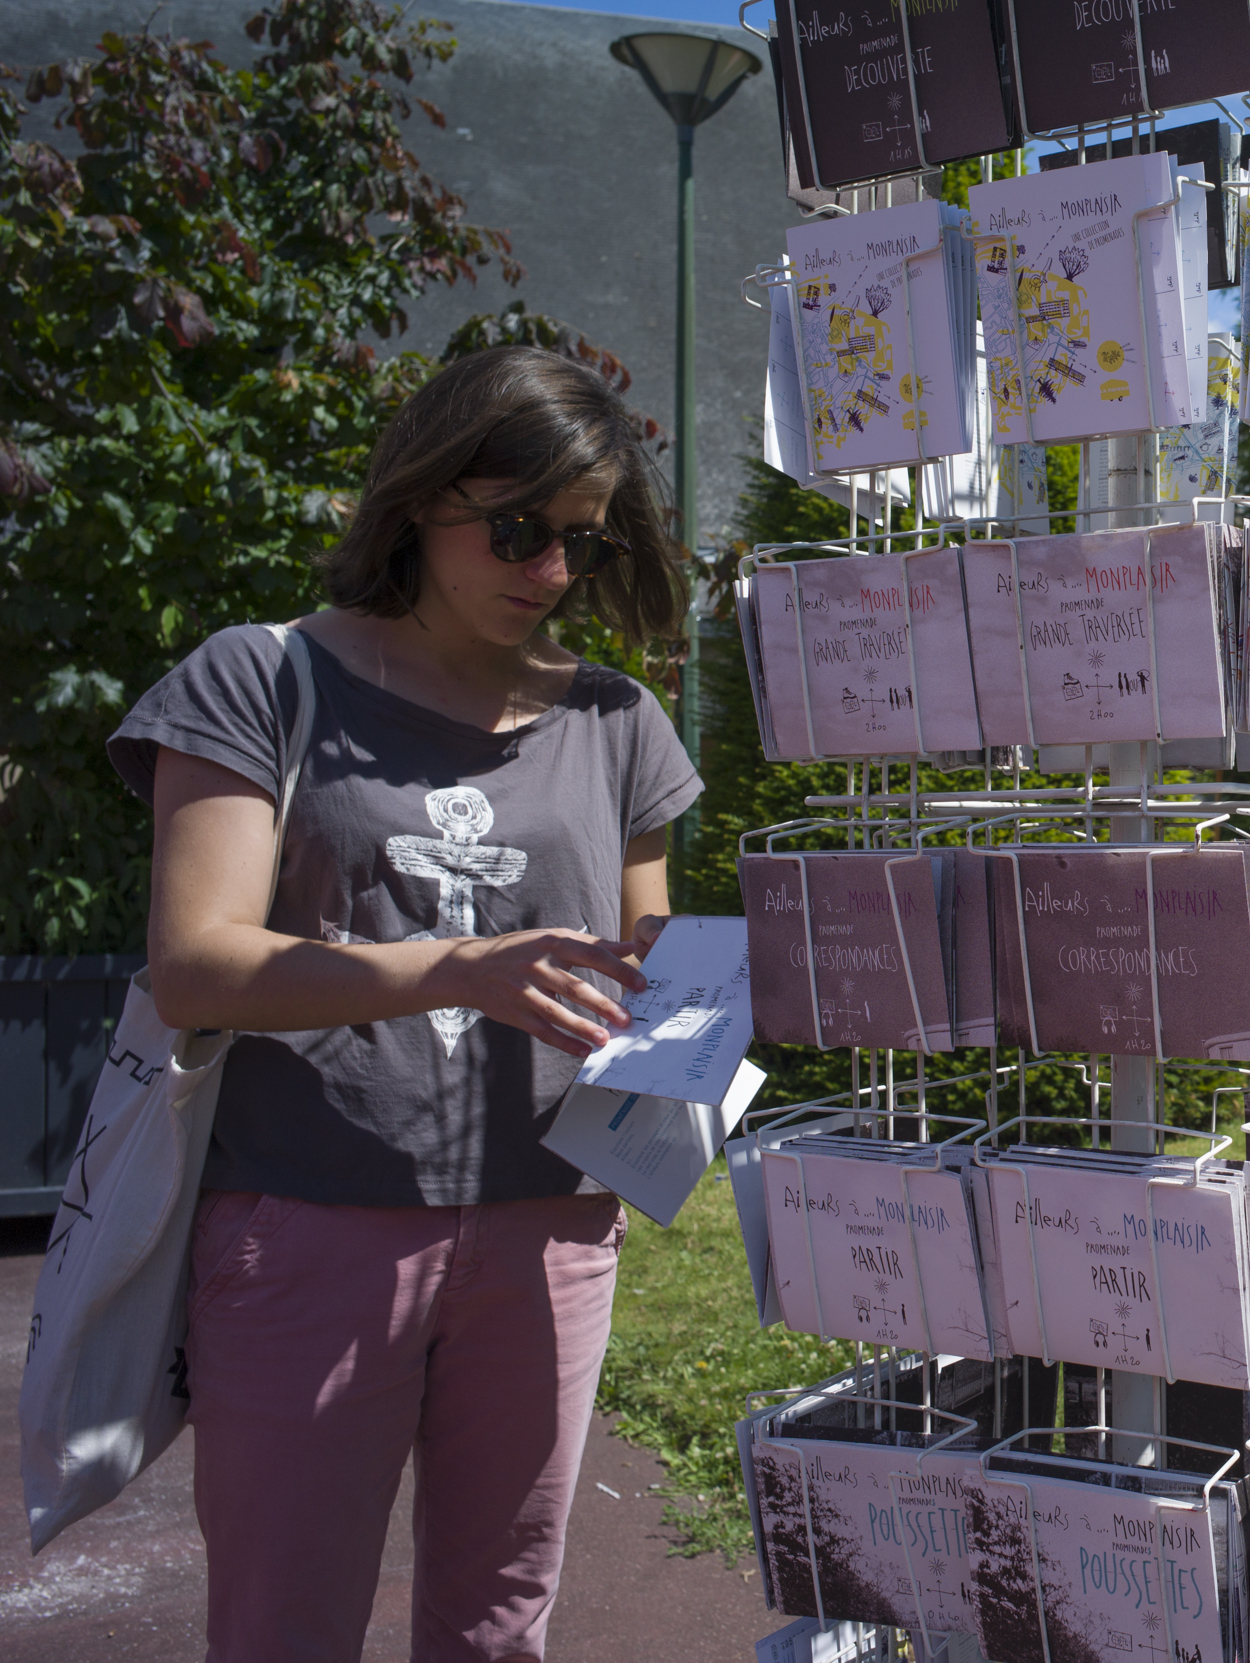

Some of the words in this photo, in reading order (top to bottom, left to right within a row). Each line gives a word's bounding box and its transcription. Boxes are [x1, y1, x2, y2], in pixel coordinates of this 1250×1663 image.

[859, 34, 899, 55] PROMENADE
[1060, 190, 1122, 220] MONPLAISIR
[1071, 232, 1081, 244] UNE
[1080, 219, 1110, 241] COLLECTION
[1087, 239, 1096, 251] DE
[1094, 226, 1125, 248] PROMENADES
[866, 232, 920, 260] MONPLAISIR
[1060, 597, 1105, 613] PROMENADE
[839, 617, 877, 632] PROMENADE
[1030, 620, 1074, 651] GRANDE
[1078, 606, 1146, 644] TRAVERSÉE
[813, 638, 851, 667] GRANDE
[818, 924, 854, 936] PROMENADE
[1096, 925, 1142, 938] PROMENADE
[667, 987, 707, 1028] PARTIR
[685, 1017, 733, 1082] MONPLAISIR
[845, 1223, 885, 1237] PROMENADE
[1086, 1241, 1130, 1256] PROMENADE
[850, 1245, 904, 1279] PARTIR
[1091, 1265, 1151, 1303] PARTIR
[899, 1497, 936, 1507] PROMENADES
[1113, 1513, 1201, 1555] MONPAISIR
[1112, 1542, 1151, 1555] PROMENADES
